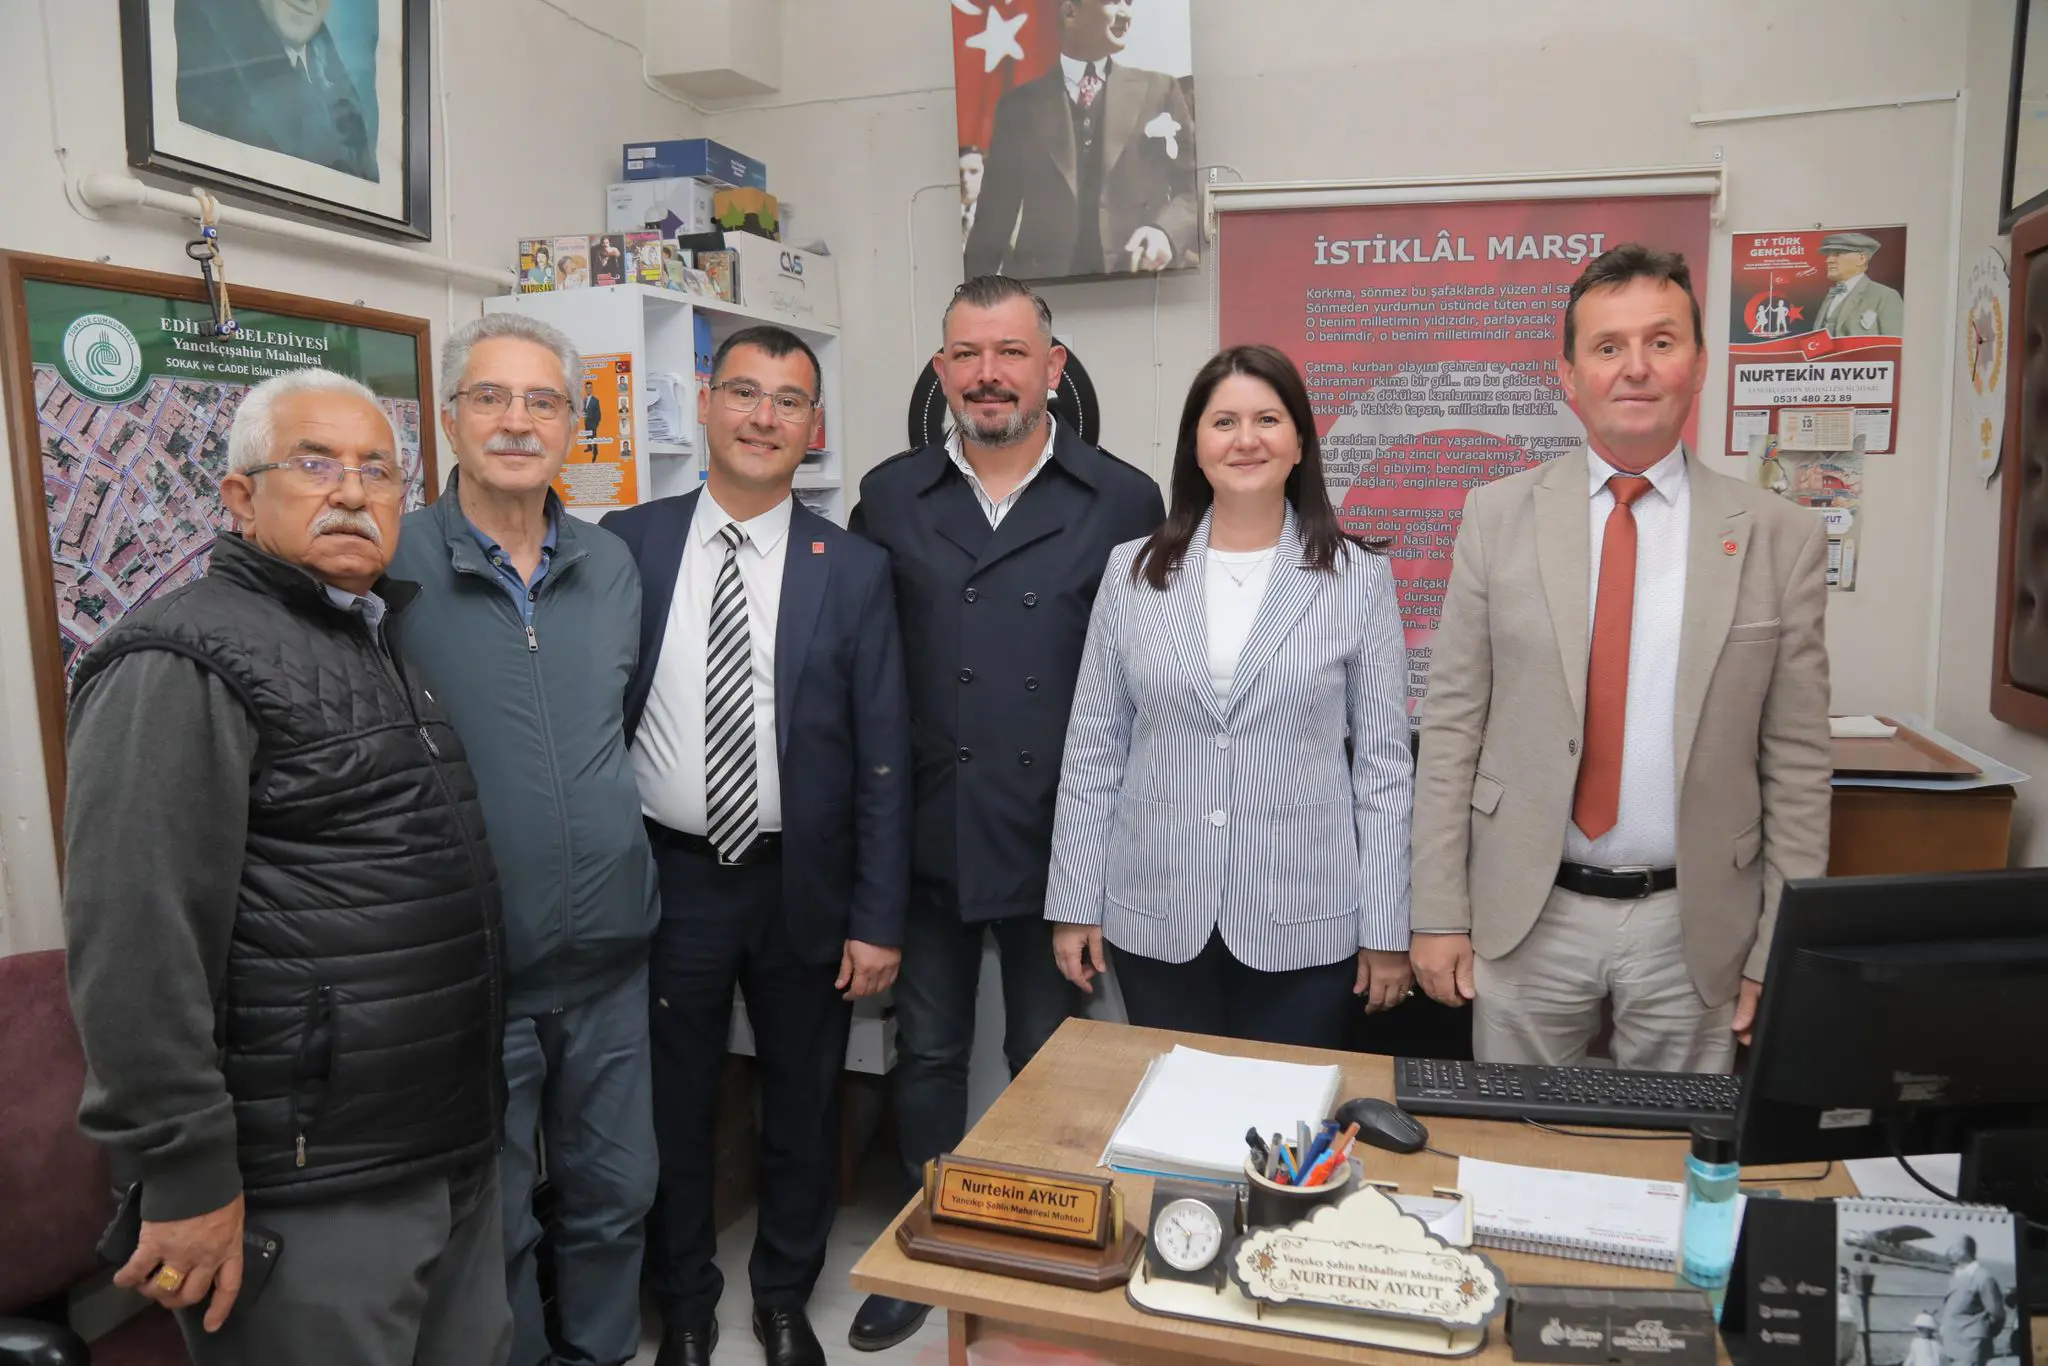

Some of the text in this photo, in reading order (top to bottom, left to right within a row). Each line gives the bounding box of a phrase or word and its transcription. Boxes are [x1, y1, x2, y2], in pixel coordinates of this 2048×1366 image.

[1314, 229, 1605, 265] İSTİKLÂL MARŞI
[1754, 236, 1801, 247] EY TÜRK
[1750, 246, 1805, 257] GENÇLİĞİ!
[1306, 288, 1356, 300] Korkma,
[1360, 287, 1407, 297] sönmez
[1411, 286, 1427, 297] bu
[1431, 284, 1495, 298] şafaklarda
[1499, 284, 1536, 297] yüzen
[1541, 282, 1552, 294] al
[1306, 302, 1369, 314] Sönmeden
[1373, 301, 1436, 314] yurdumun
[1440, 300, 1489, 311] üstünde
[1494, 299, 1526, 310] tüten
[1531, 301, 1546, 309] en
[1306, 314, 1556, 328] O benim milletimin yıldızıdır, parlayacak;
[235, 327, 329, 351] BELEDİYESİ
[1306, 327, 1555, 342] O benimdir, o benim milletimindir ancak.
[266, 347, 322, 366] Mahallesi
[166, 357, 201, 370] SOKAK
[202, 362, 215, 372] ve
[218, 364, 249, 375] CADDE
[1305, 359, 1559, 374] Çatma, kurban olayım çehreni ey nazlı hil
[1739, 364, 1889, 382] NURTEKİN AYKUT
[1305, 376, 1366, 387] Kahraman
[1370, 375, 1409, 387] ırkıma
[1411, 374, 1429, 387] bir
[1464, 375, 1481, 387] ne
[1483, 373, 1500, 386] bu
[1502, 373, 1542, 388] şiddet
[1546, 373, 1561, 386] bu
[1306, 389, 1334, 401] Sana
[1338, 389, 1376, 401] olmaz
[1376, 388, 1425, 401] dökülen
[1428, 388, 1494, 401] kanlarımız
[1495, 389, 1532, 401] sonra
[1773, 394, 1852, 404] 0531 480 23 89
[1405, 404, 1445, 417] tapan,
[1447, 403, 1510, 416] milletimin
[1512, 402, 1558, 416] istiklâl.
[1330, 433, 1377, 446] ezelden
[1379, 433, 1418, 446] beridir
[1421, 434, 1444, 445] hür
[1447, 435, 1501, 448] yaşadım,
[1505, 434, 1530, 446] hür
[1320, 447, 1339, 461] ngi
[1341, 447, 1373, 461] çılgın
[1376, 447, 1405, 459] bana
[1409, 448, 1441, 459] zincir
[1446, 448, 1521, 461] vuracakmış?
[1323, 462, 1361, 475] remiş
[1361, 462, 1379, 473] sel
[1383, 462, 1431, 475] gibiyim;
[1436, 463, 1484, 474] bendimi
[1324, 477, 1352, 487] arım
[1353, 476, 1398, 489] dağları,
[1402, 477, 1458, 490] enginlere
[1349, 505, 1388, 517] âfâkını
[1392, 506, 1444, 520] sarmışsa
[1825, 515, 1842, 523] KUT
[1376, 519, 1401, 531] dolu
[1405, 519, 1452, 533] göğsüm
[1403, 534, 1431, 545] Nasıl
[1428, 548, 1445, 560] tek
[1412, 578, 1448, 591] alçakl
[961, 1177, 1079, 1209] Nurtekin AYKUT
[986, 1200, 1009, 1212] Şahin
[1010, 1205, 1050, 1219] Mahallesi
[1051, 1212, 1085, 1224] Muhtarı
[1326, 1259, 1355, 1272] Şahin
[1357, 1262, 1408, 1278] Mahallesi
[1290, 1267, 1444, 1300] NURTEKİN AYKUT
